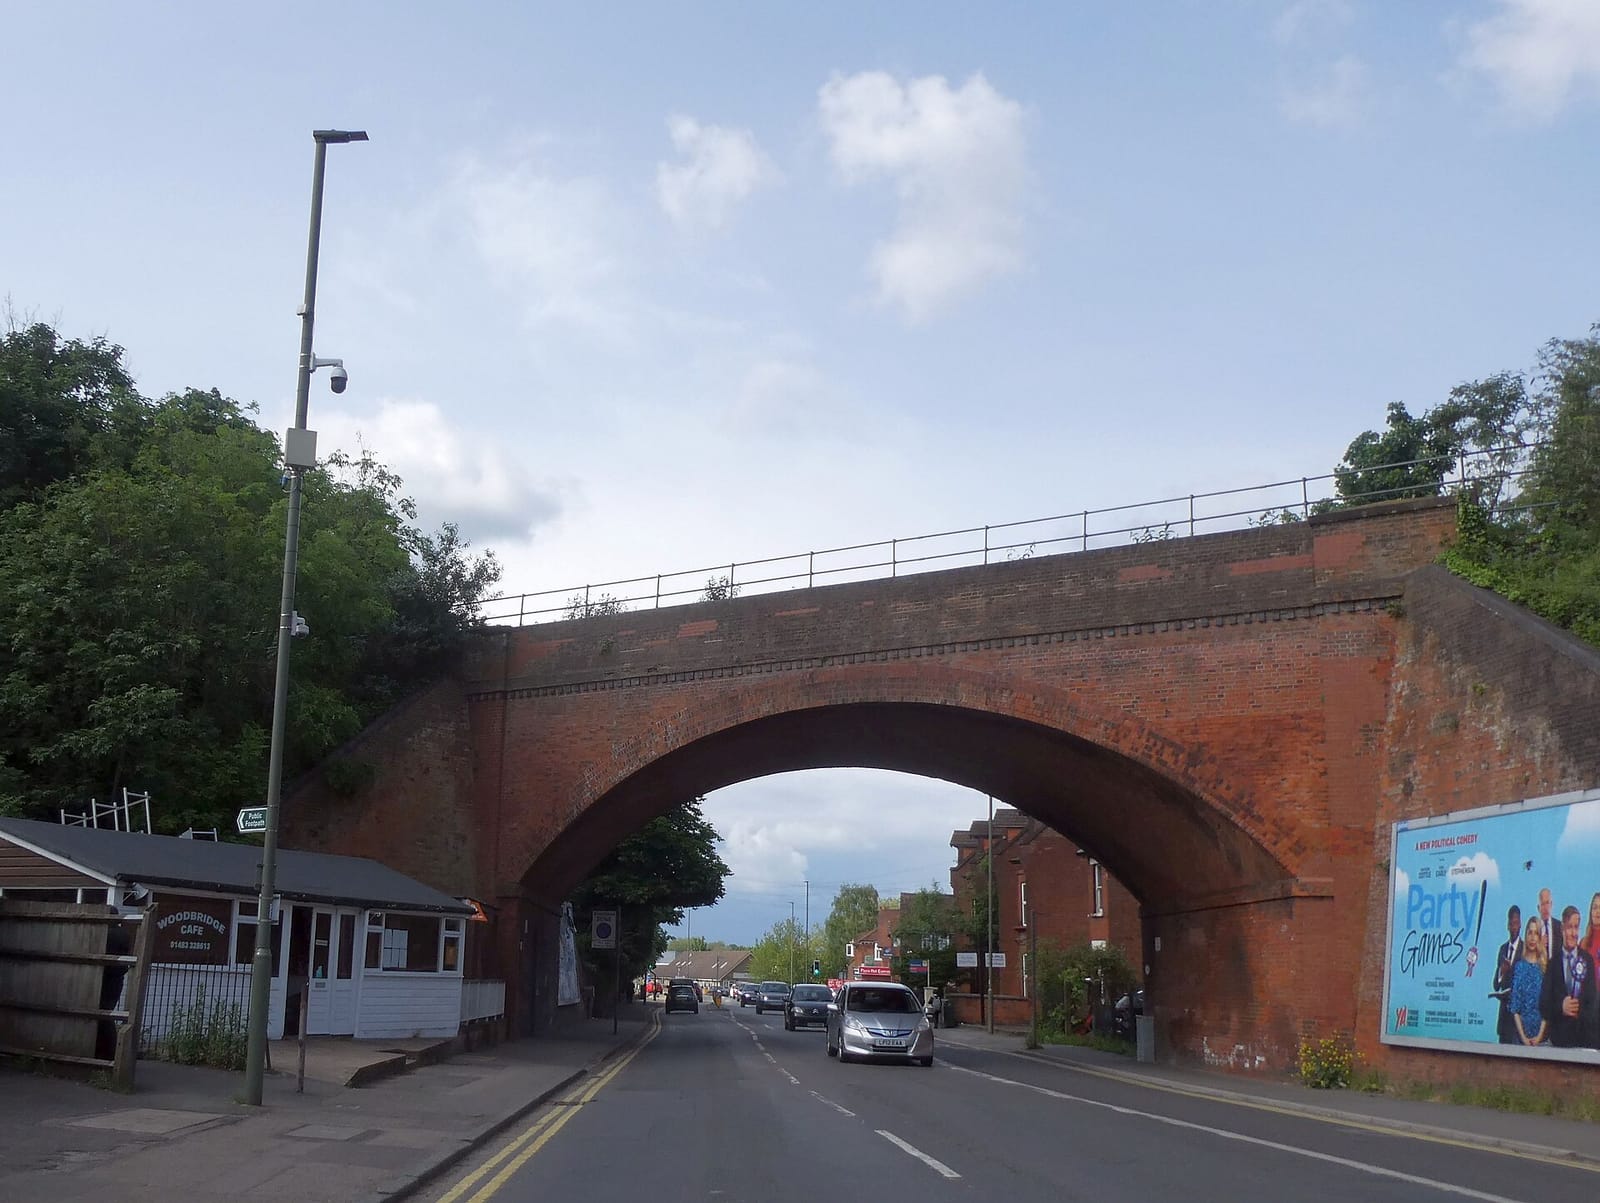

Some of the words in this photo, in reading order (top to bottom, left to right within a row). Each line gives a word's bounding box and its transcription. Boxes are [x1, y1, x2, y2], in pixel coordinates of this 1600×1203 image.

[245, 820, 265, 828] Footpath
[1420, 840, 1431, 850] NEW
[1431, 836, 1456, 849] POLITICAL
[1456, 833, 1479, 846] COMEDY
[1406, 883, 1479, 941] Party
[157, 911, 226, 935] WOODBRIDGE
[180, 924, 204, 936] CAFE
